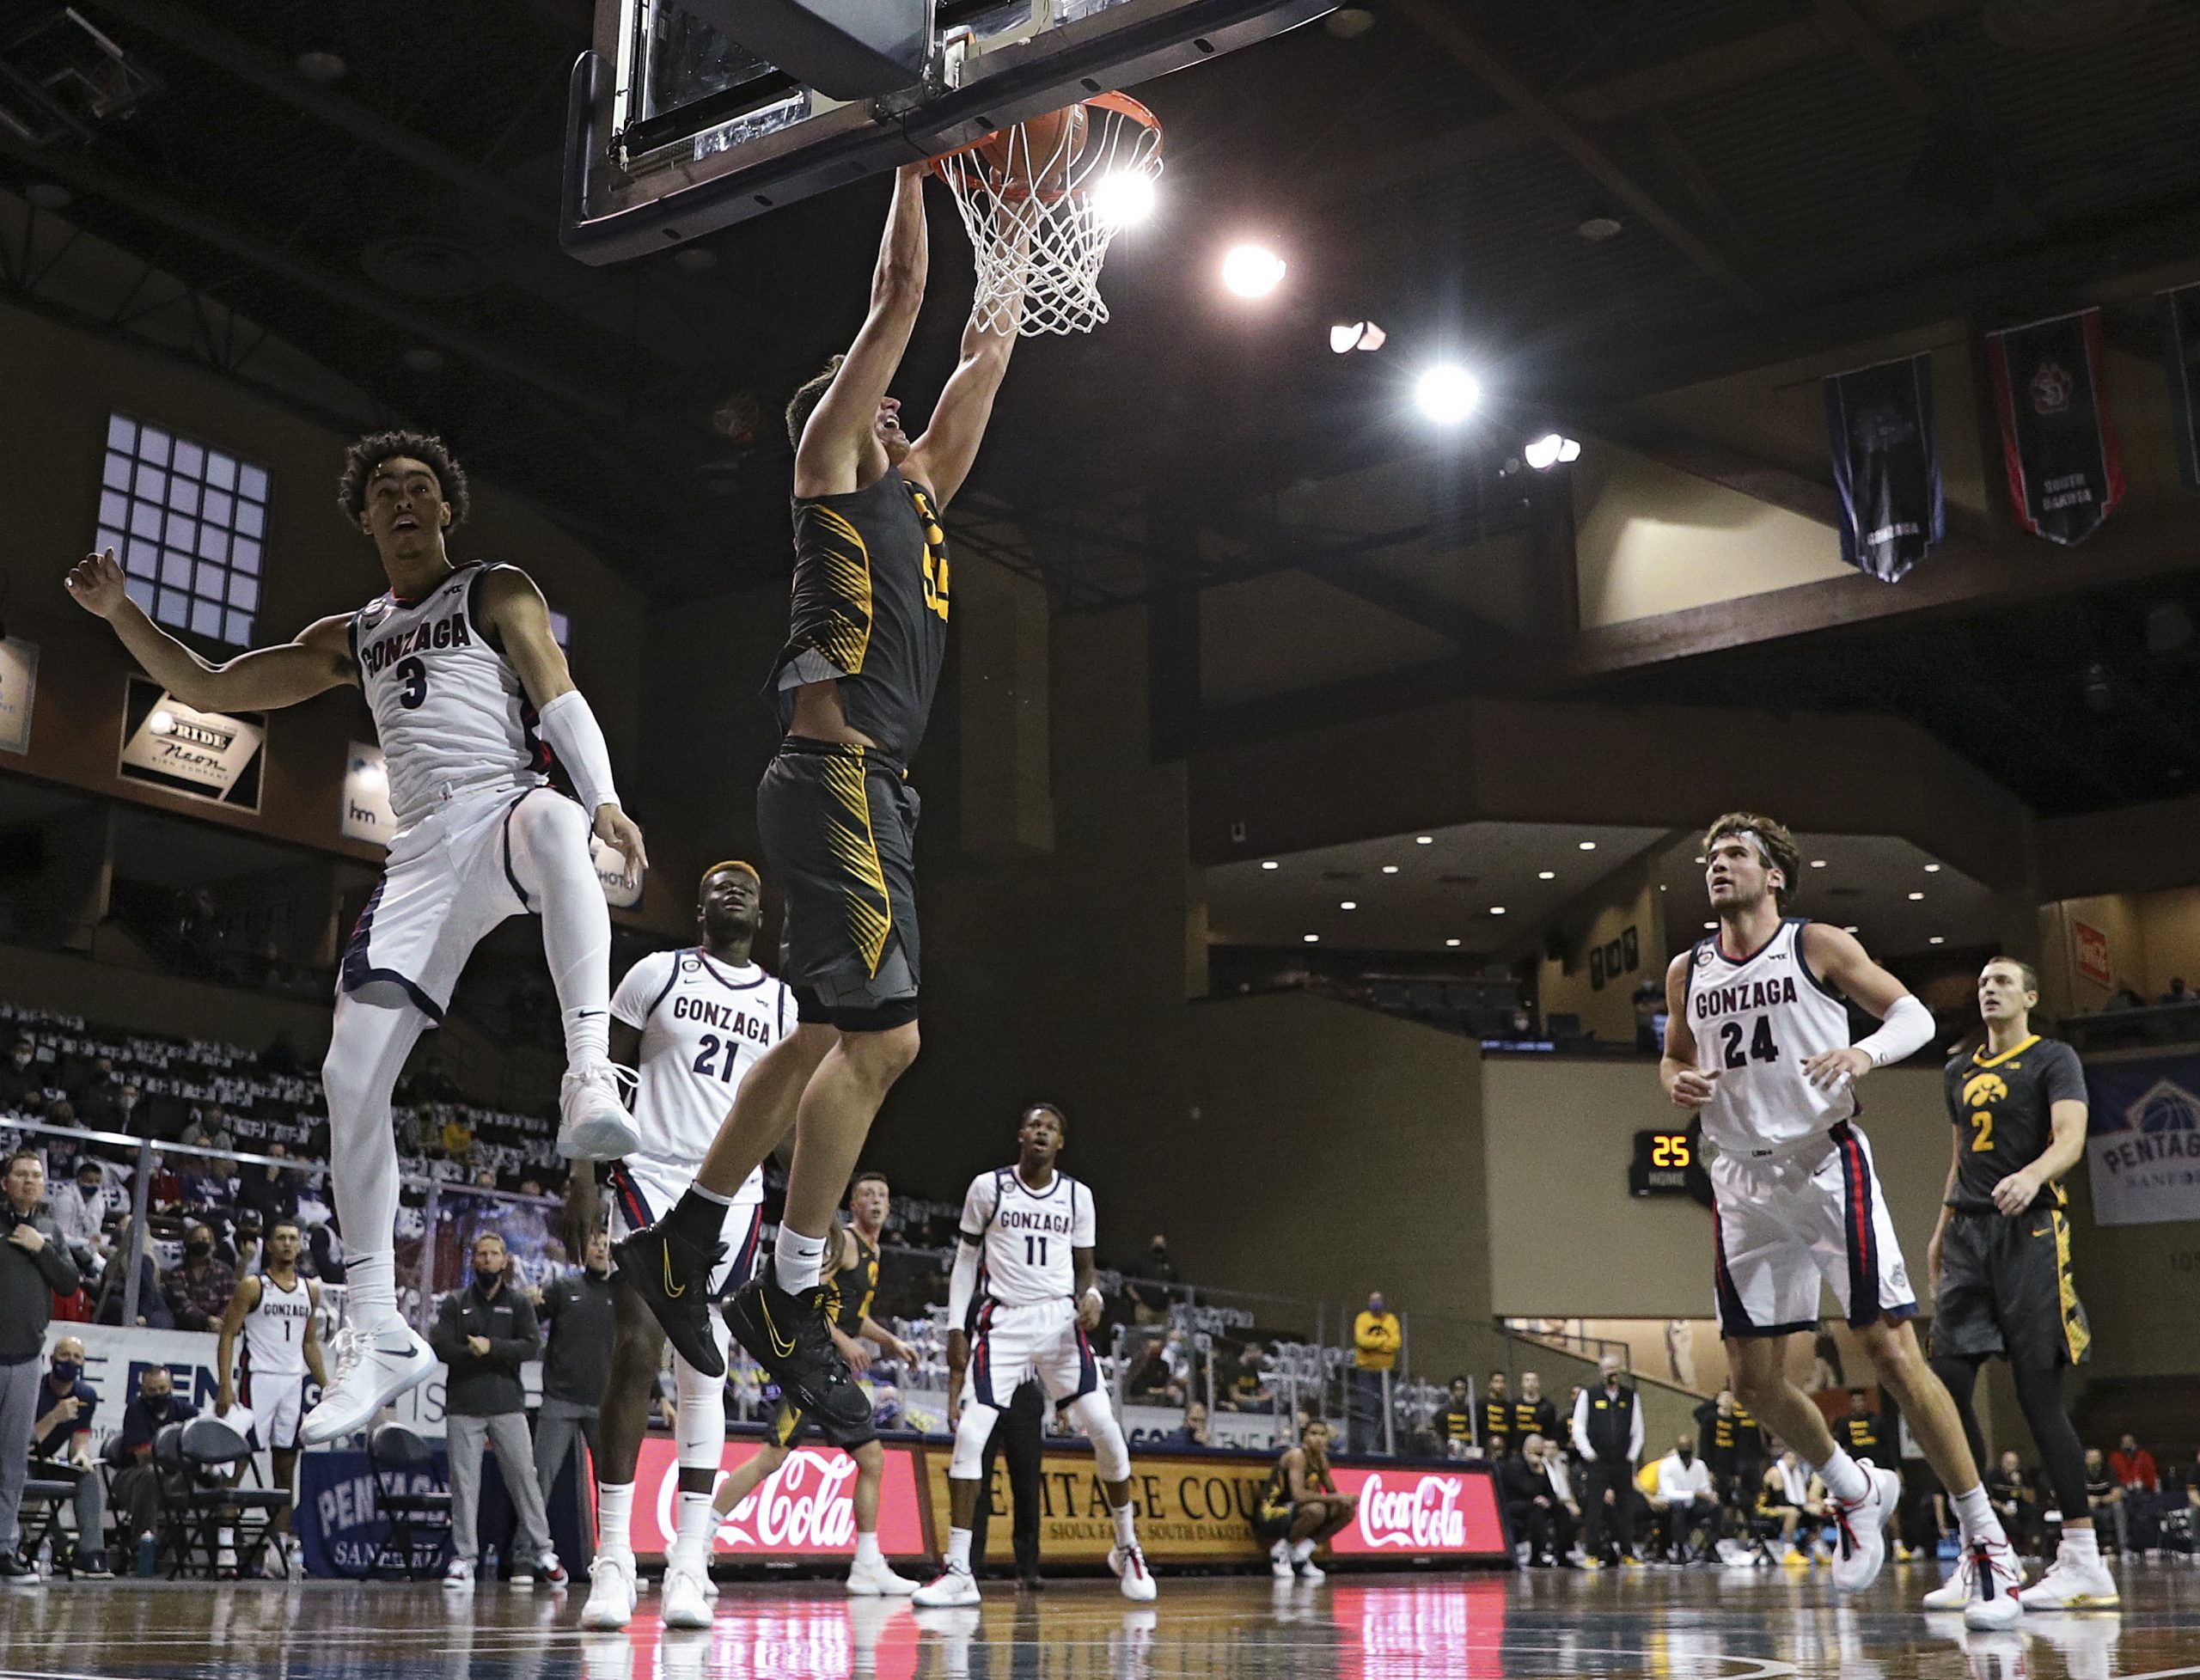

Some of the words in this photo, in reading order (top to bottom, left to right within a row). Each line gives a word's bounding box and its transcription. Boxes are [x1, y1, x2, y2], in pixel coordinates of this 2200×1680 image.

[361, 613, 472, 678] GONZAGA
[396, 657, 427, 709] 3
[156, 739, 227, 772] Neon
[1696, 976, 1798, 1020] GONZAGA
[674, 996, 770, 1048] GONZAGA
[1720, 1015, 1780, 1070] 24
[693, 1034, 740, 1084] 21
[1652, 1134, 1690, 1168] 25
[1971, 1110, 1994, 1152] 2
[1024, 1235, 1048, 1267] 11
[284, 1320, 290, 1341] 1
